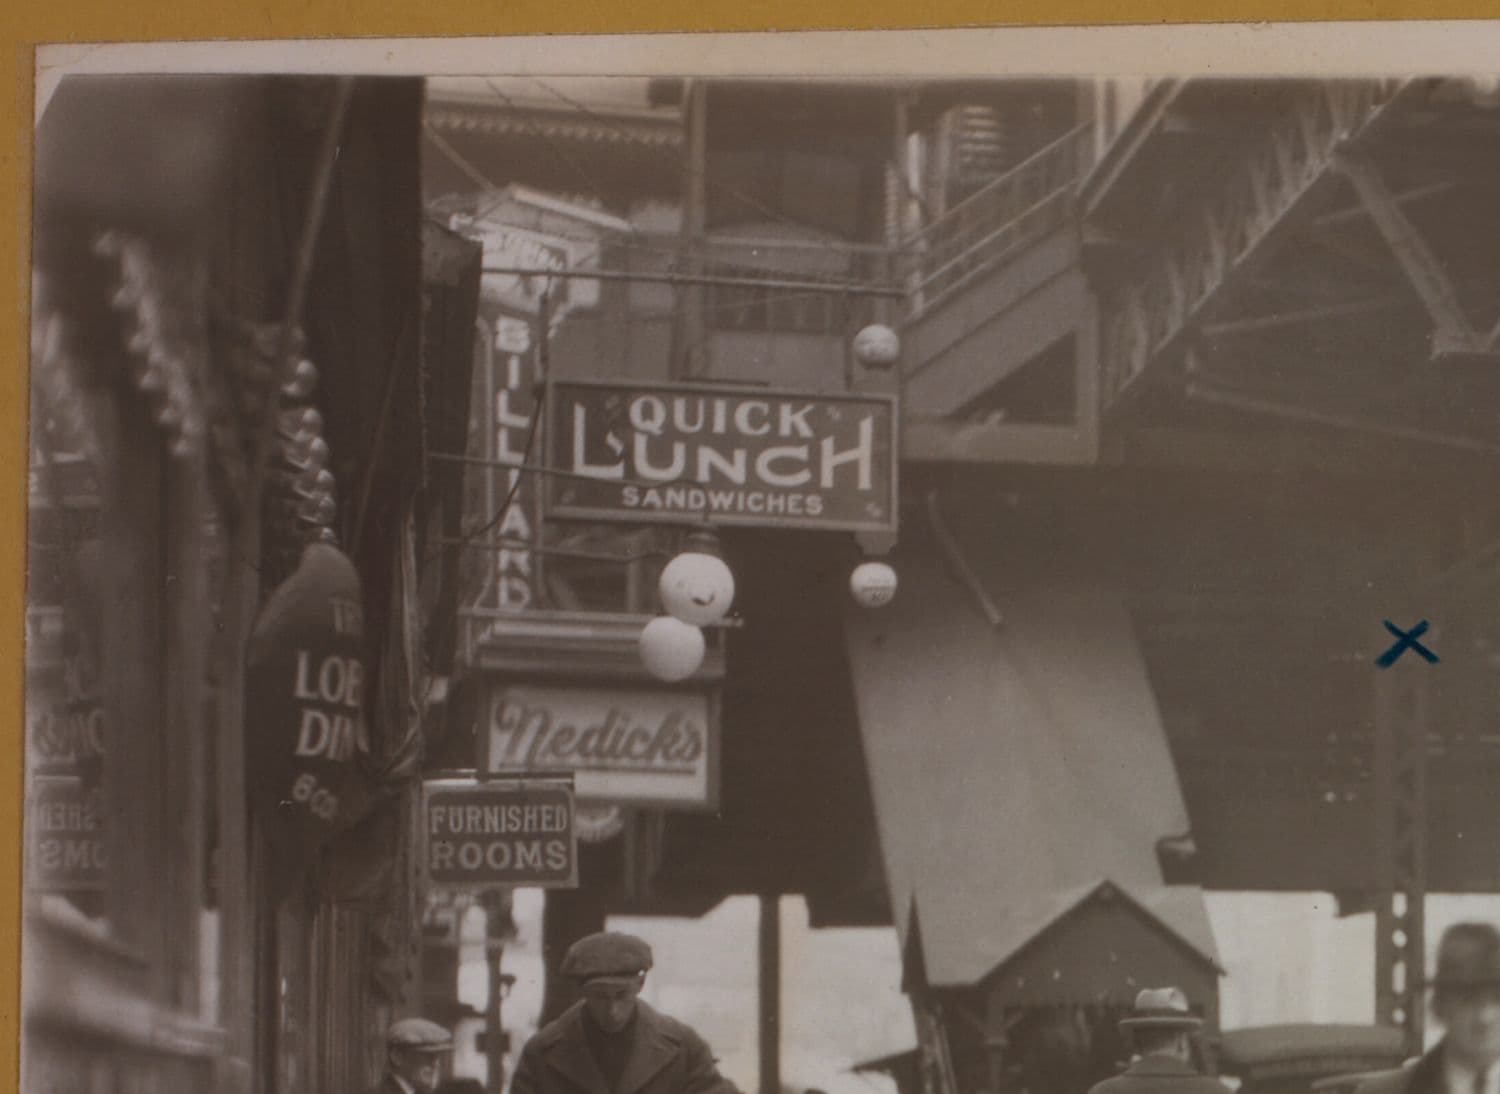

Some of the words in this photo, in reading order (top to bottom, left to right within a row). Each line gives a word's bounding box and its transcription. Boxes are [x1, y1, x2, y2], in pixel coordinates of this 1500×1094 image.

[628, 395, 817, 438] QUICK
[494, 314, 532, 611] BILLIARD
[572, 401, 874, 491] LUNCH
[621, 487, 825, 516] SANDWICHES
[430, 805, 568, 834] FURNISHED
[430, 839, 568, 871] ROOMS
